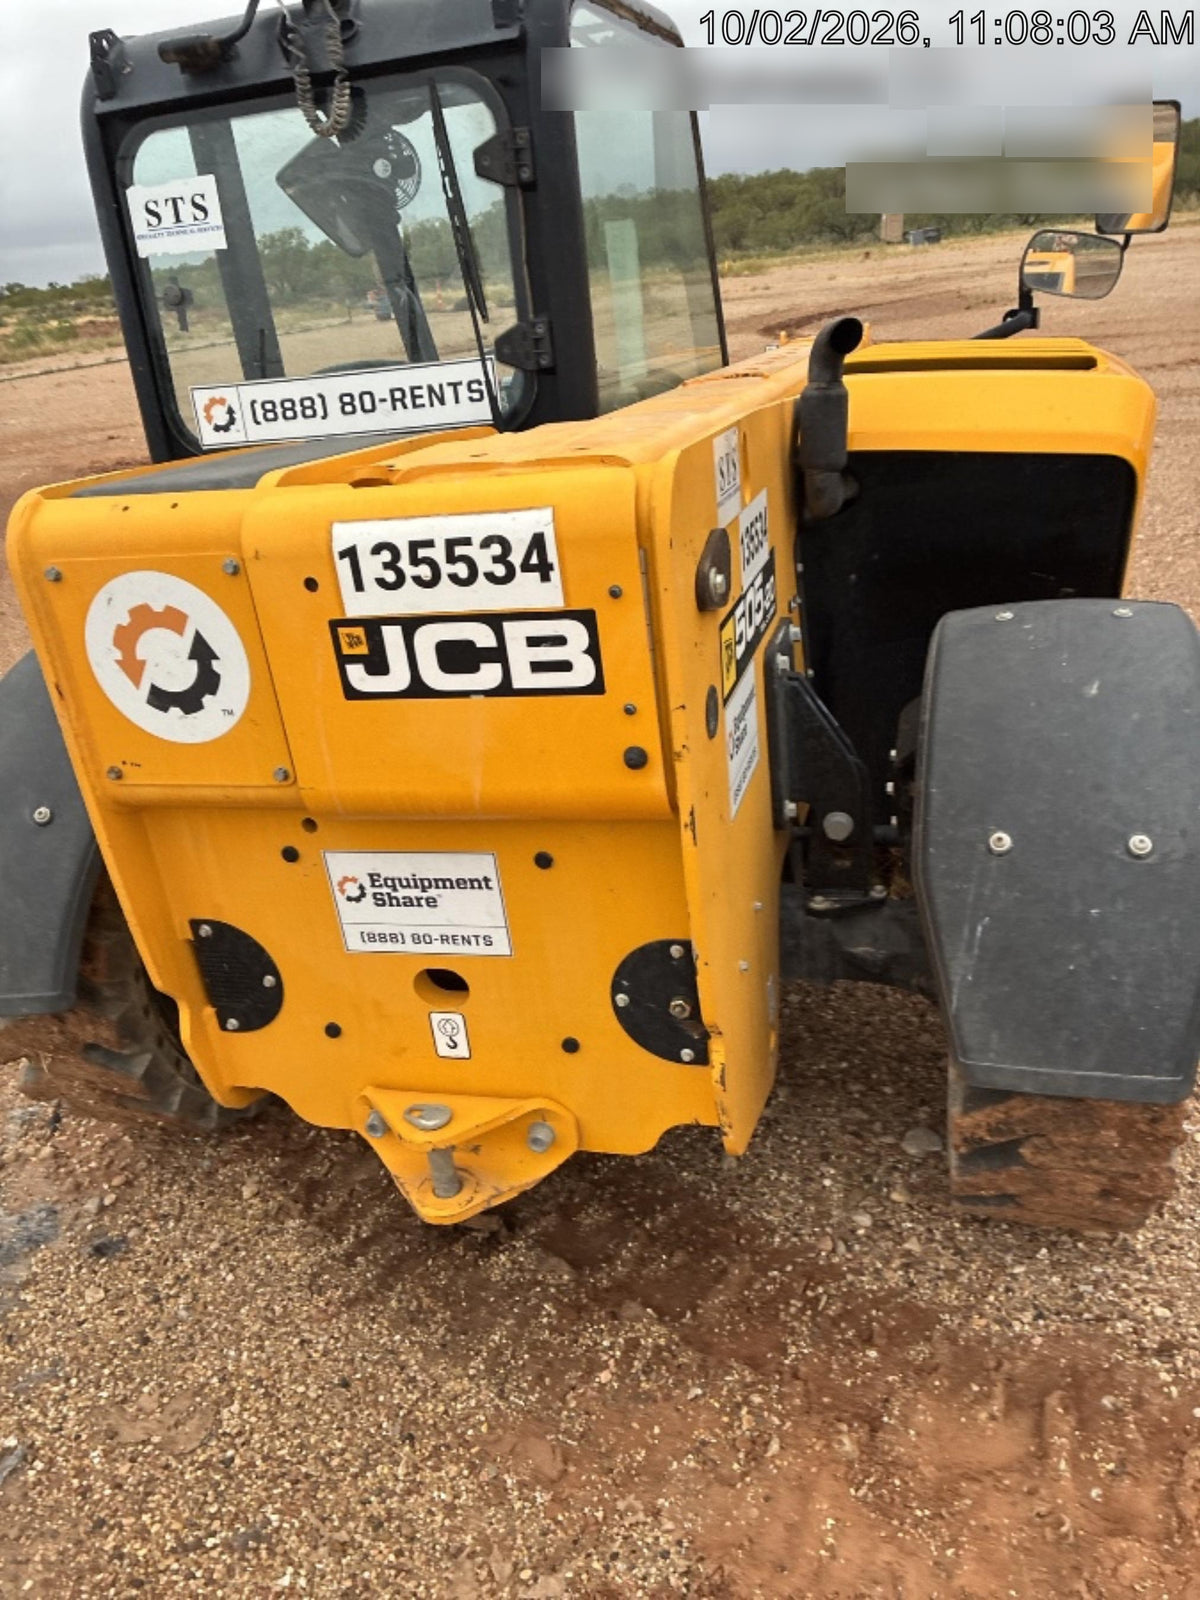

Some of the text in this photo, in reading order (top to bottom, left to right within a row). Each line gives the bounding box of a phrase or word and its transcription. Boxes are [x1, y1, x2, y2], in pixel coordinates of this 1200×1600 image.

[144, 193, 209, 228] STS
[250, 377, 486, 425] (888) 80-RENTS
[718, 452, 737, 492] STS
[338, 531, 555, 592] 135534
[345, 619, 596, 692] JCB
[367, 872, 494, 892] Equipment
[372, 892, 438, 908] Share
[360, 931, 494, 947] (888) 80-RENTS
